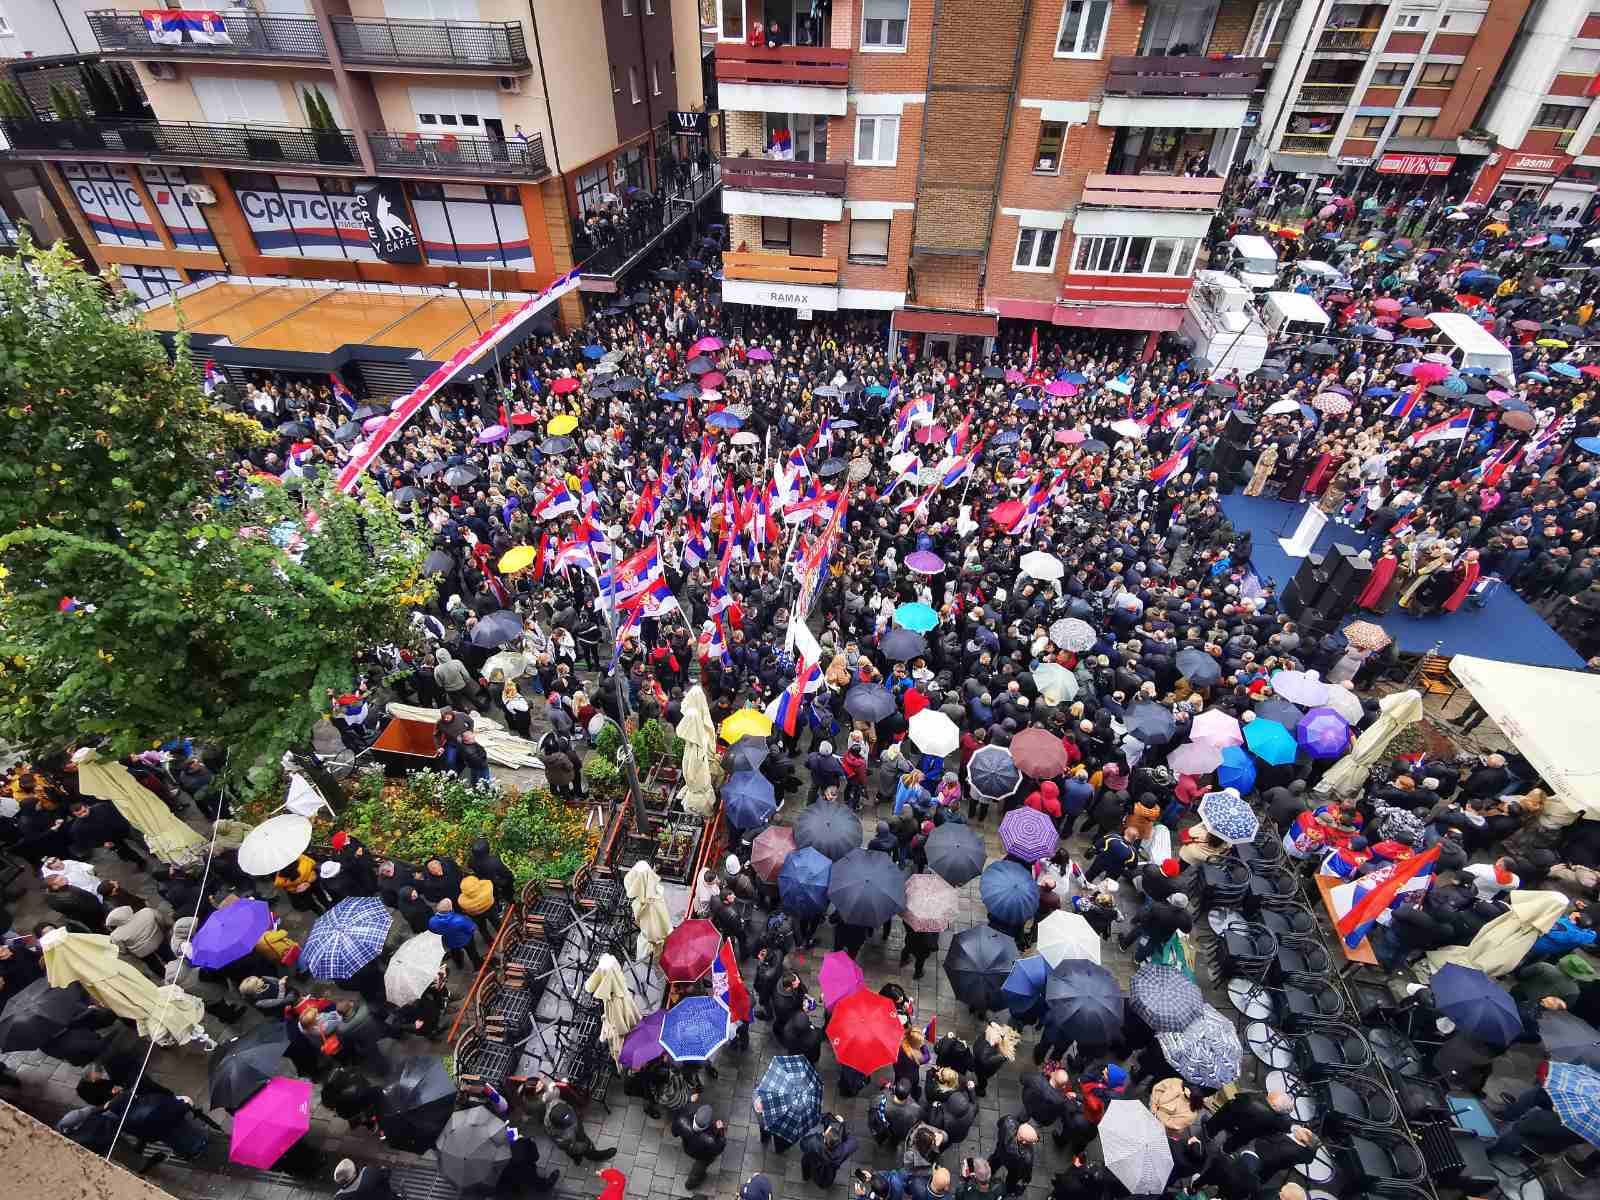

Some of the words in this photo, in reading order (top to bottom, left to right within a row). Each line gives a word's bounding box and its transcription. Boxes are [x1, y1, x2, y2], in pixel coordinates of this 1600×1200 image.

[1516, 157, 1554, 169] Jasmil
[76, 185, 143, 207] СНС
[240, 191, 363, 223] Српска
[356, 195, 382, 254] GREY
[386, 236, 417, 253] CAFFE
[770, 292, 808, 303] RAMAX
